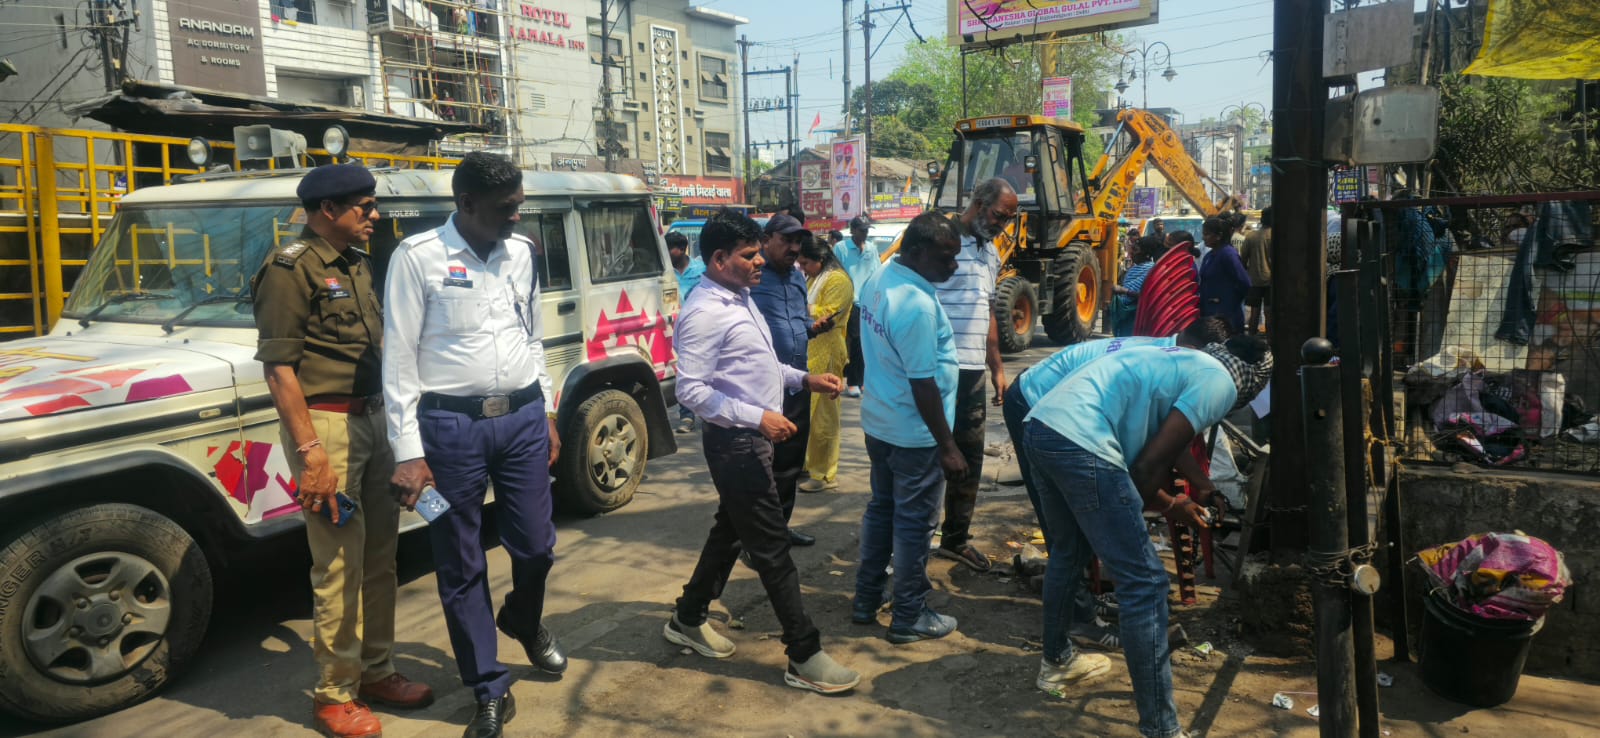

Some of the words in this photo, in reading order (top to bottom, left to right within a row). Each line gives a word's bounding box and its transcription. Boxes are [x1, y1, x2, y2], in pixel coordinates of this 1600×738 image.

[520, 4, 571, 28] HOTEL
[988, 11, 1026, 24] GANESHA
[1028, 6, 1060, 17] GLOBAL
[1061, 2, 1089, 12] GULAL
[179, 17, 254, 36] ANANDAM
[187, 39, 200, 47] AC
[202, 40, 250, 53] DORMITORY
[210, 56, 241, 67] ROOMS
[389, 210, 421, 218] BOLERO
